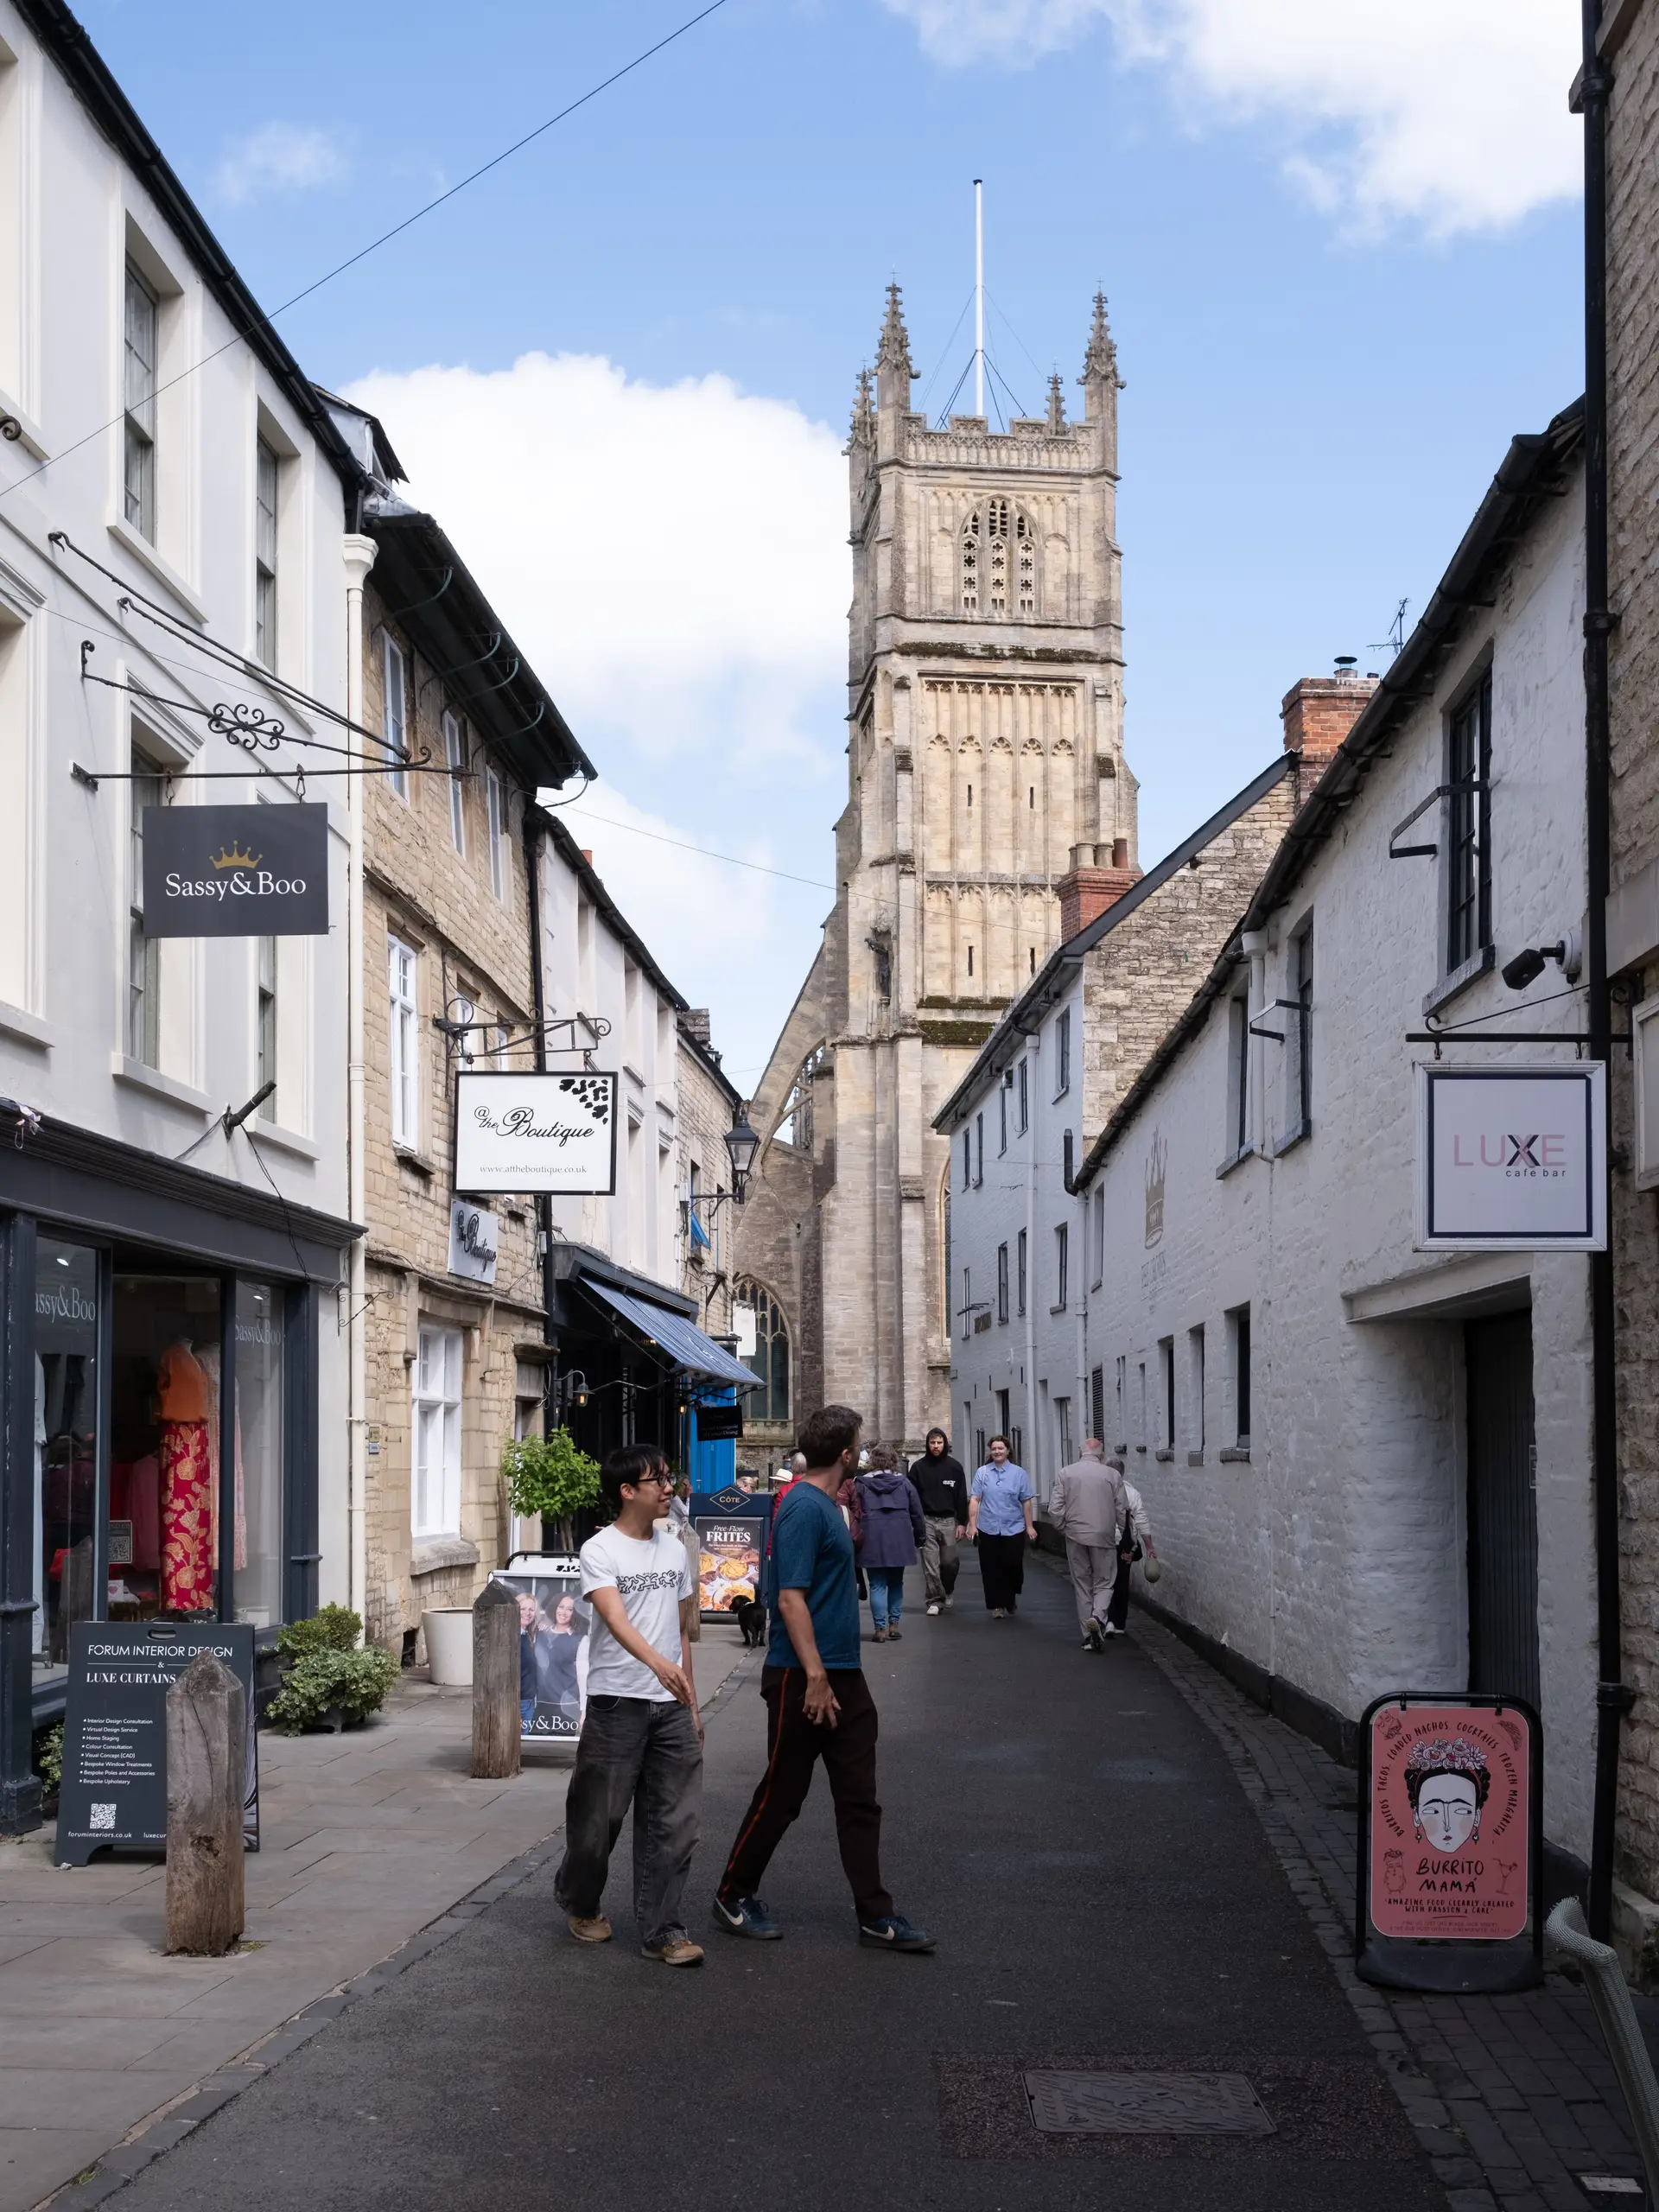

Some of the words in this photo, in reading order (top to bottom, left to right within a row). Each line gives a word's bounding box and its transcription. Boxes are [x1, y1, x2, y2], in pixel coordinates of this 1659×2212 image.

[165, 871, 307, 901] Sassy&Boo
[479, 1116, 499, 1128] the
[495, 1106, 595, 1147] Boutique
[1453, 1135, 1567, 1168] LUXE
[480, 1165, 588, 1176] www.attheboutique.co.uk
[1505, 1168, 1536, 1178] cafe
[1542, 1168, 1566, 1178] bar
[464, 1213, 497, 1273] Boutique
[35, 1285, 96, 1324] ssy&Boo
[706, 1531, 751, 1542] FRITES
[88, 1644, 130, 1656] FORUM
[132, 1645, 185, 1656] INTERIOR
[86, 1672, 117, 1683] LUXE
[119, 1673, 177, 1684] CURTAINS
[520, 1715, 580, 1732] sy&Boo
[1387, 1733, 1412, 1760] LOADED
[1498, 1752, 1518, 1785] FROZEN
[1380, 1799, 1405, 1837] BURRITOS
[1492, 1789, 1518, 1836] MARGARITA
[1415, 1857, 1484, 1876] BURRITO
[1418, 1877, 1478, 1894] MAMÁ
